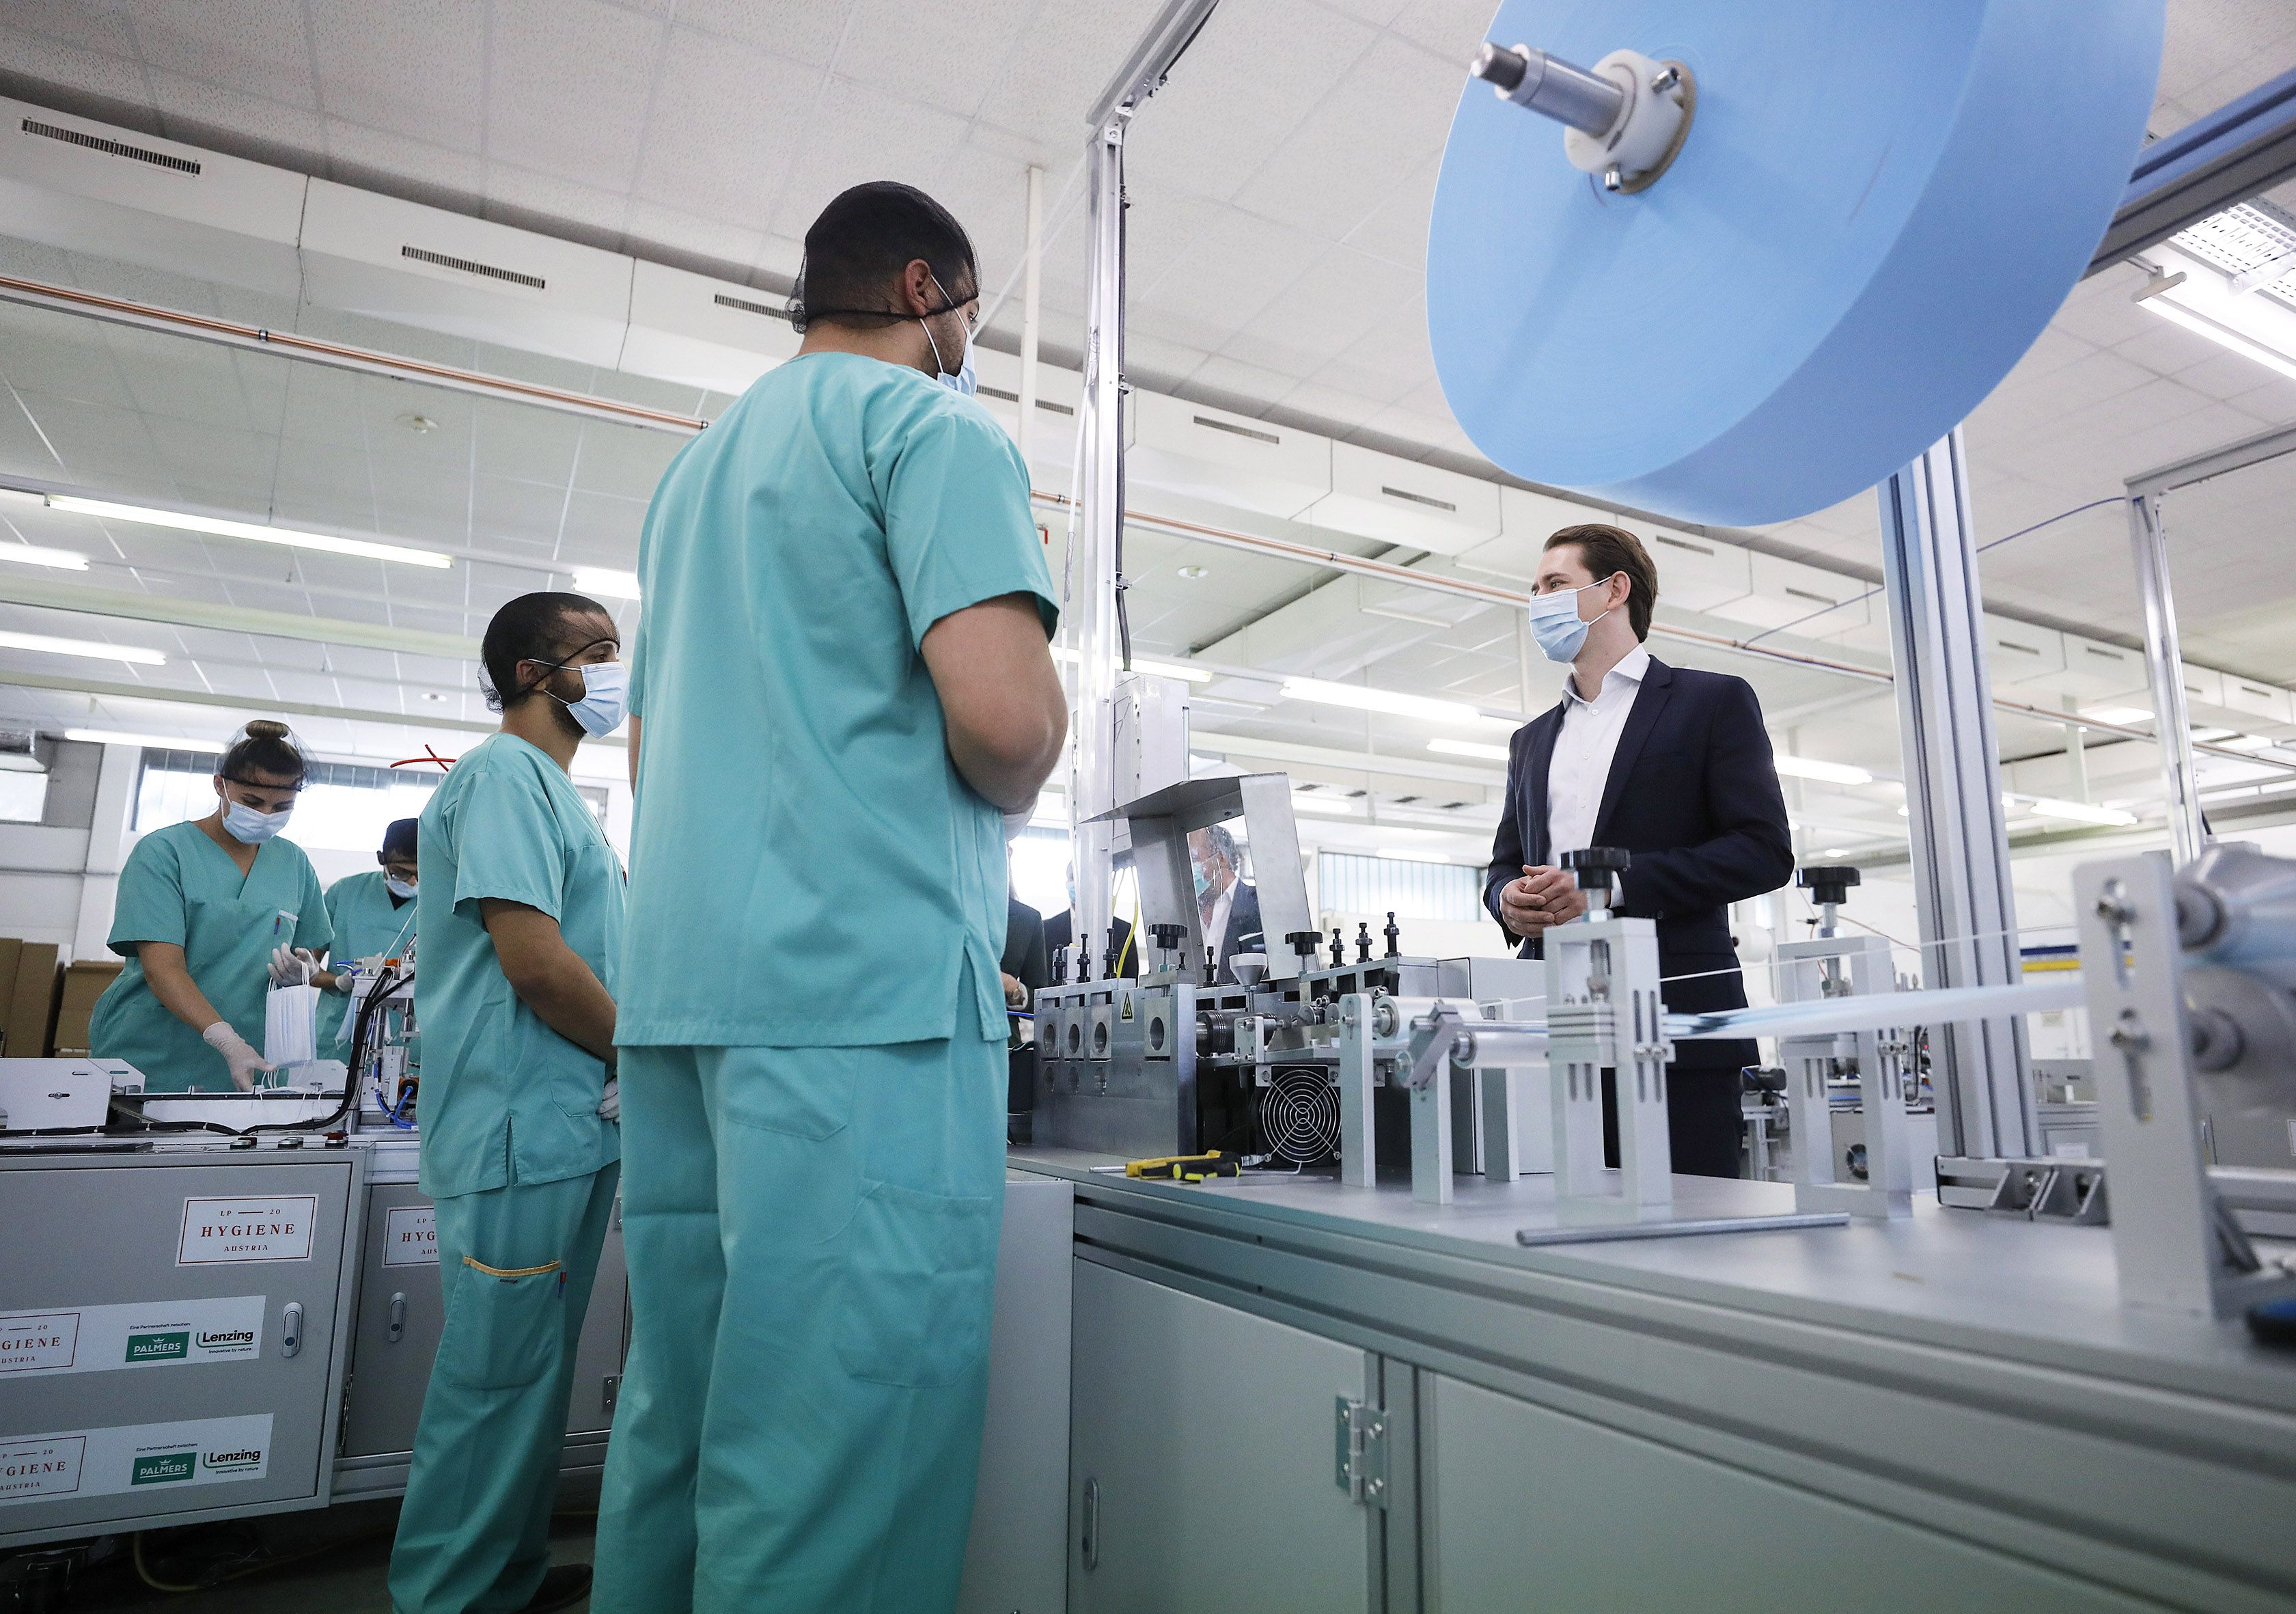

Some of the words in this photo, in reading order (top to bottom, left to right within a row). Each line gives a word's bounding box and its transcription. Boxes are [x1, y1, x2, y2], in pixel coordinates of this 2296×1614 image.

[201, 1223, 295, 1237] HYGIENE
[202, 1330, 253, 1343] Lenzing
[134, 1343, 181, 1353] PALMERS
[210, 1449, 261, 1463] Lenzing
[140, 1464, 188, 1476] PALMERS
